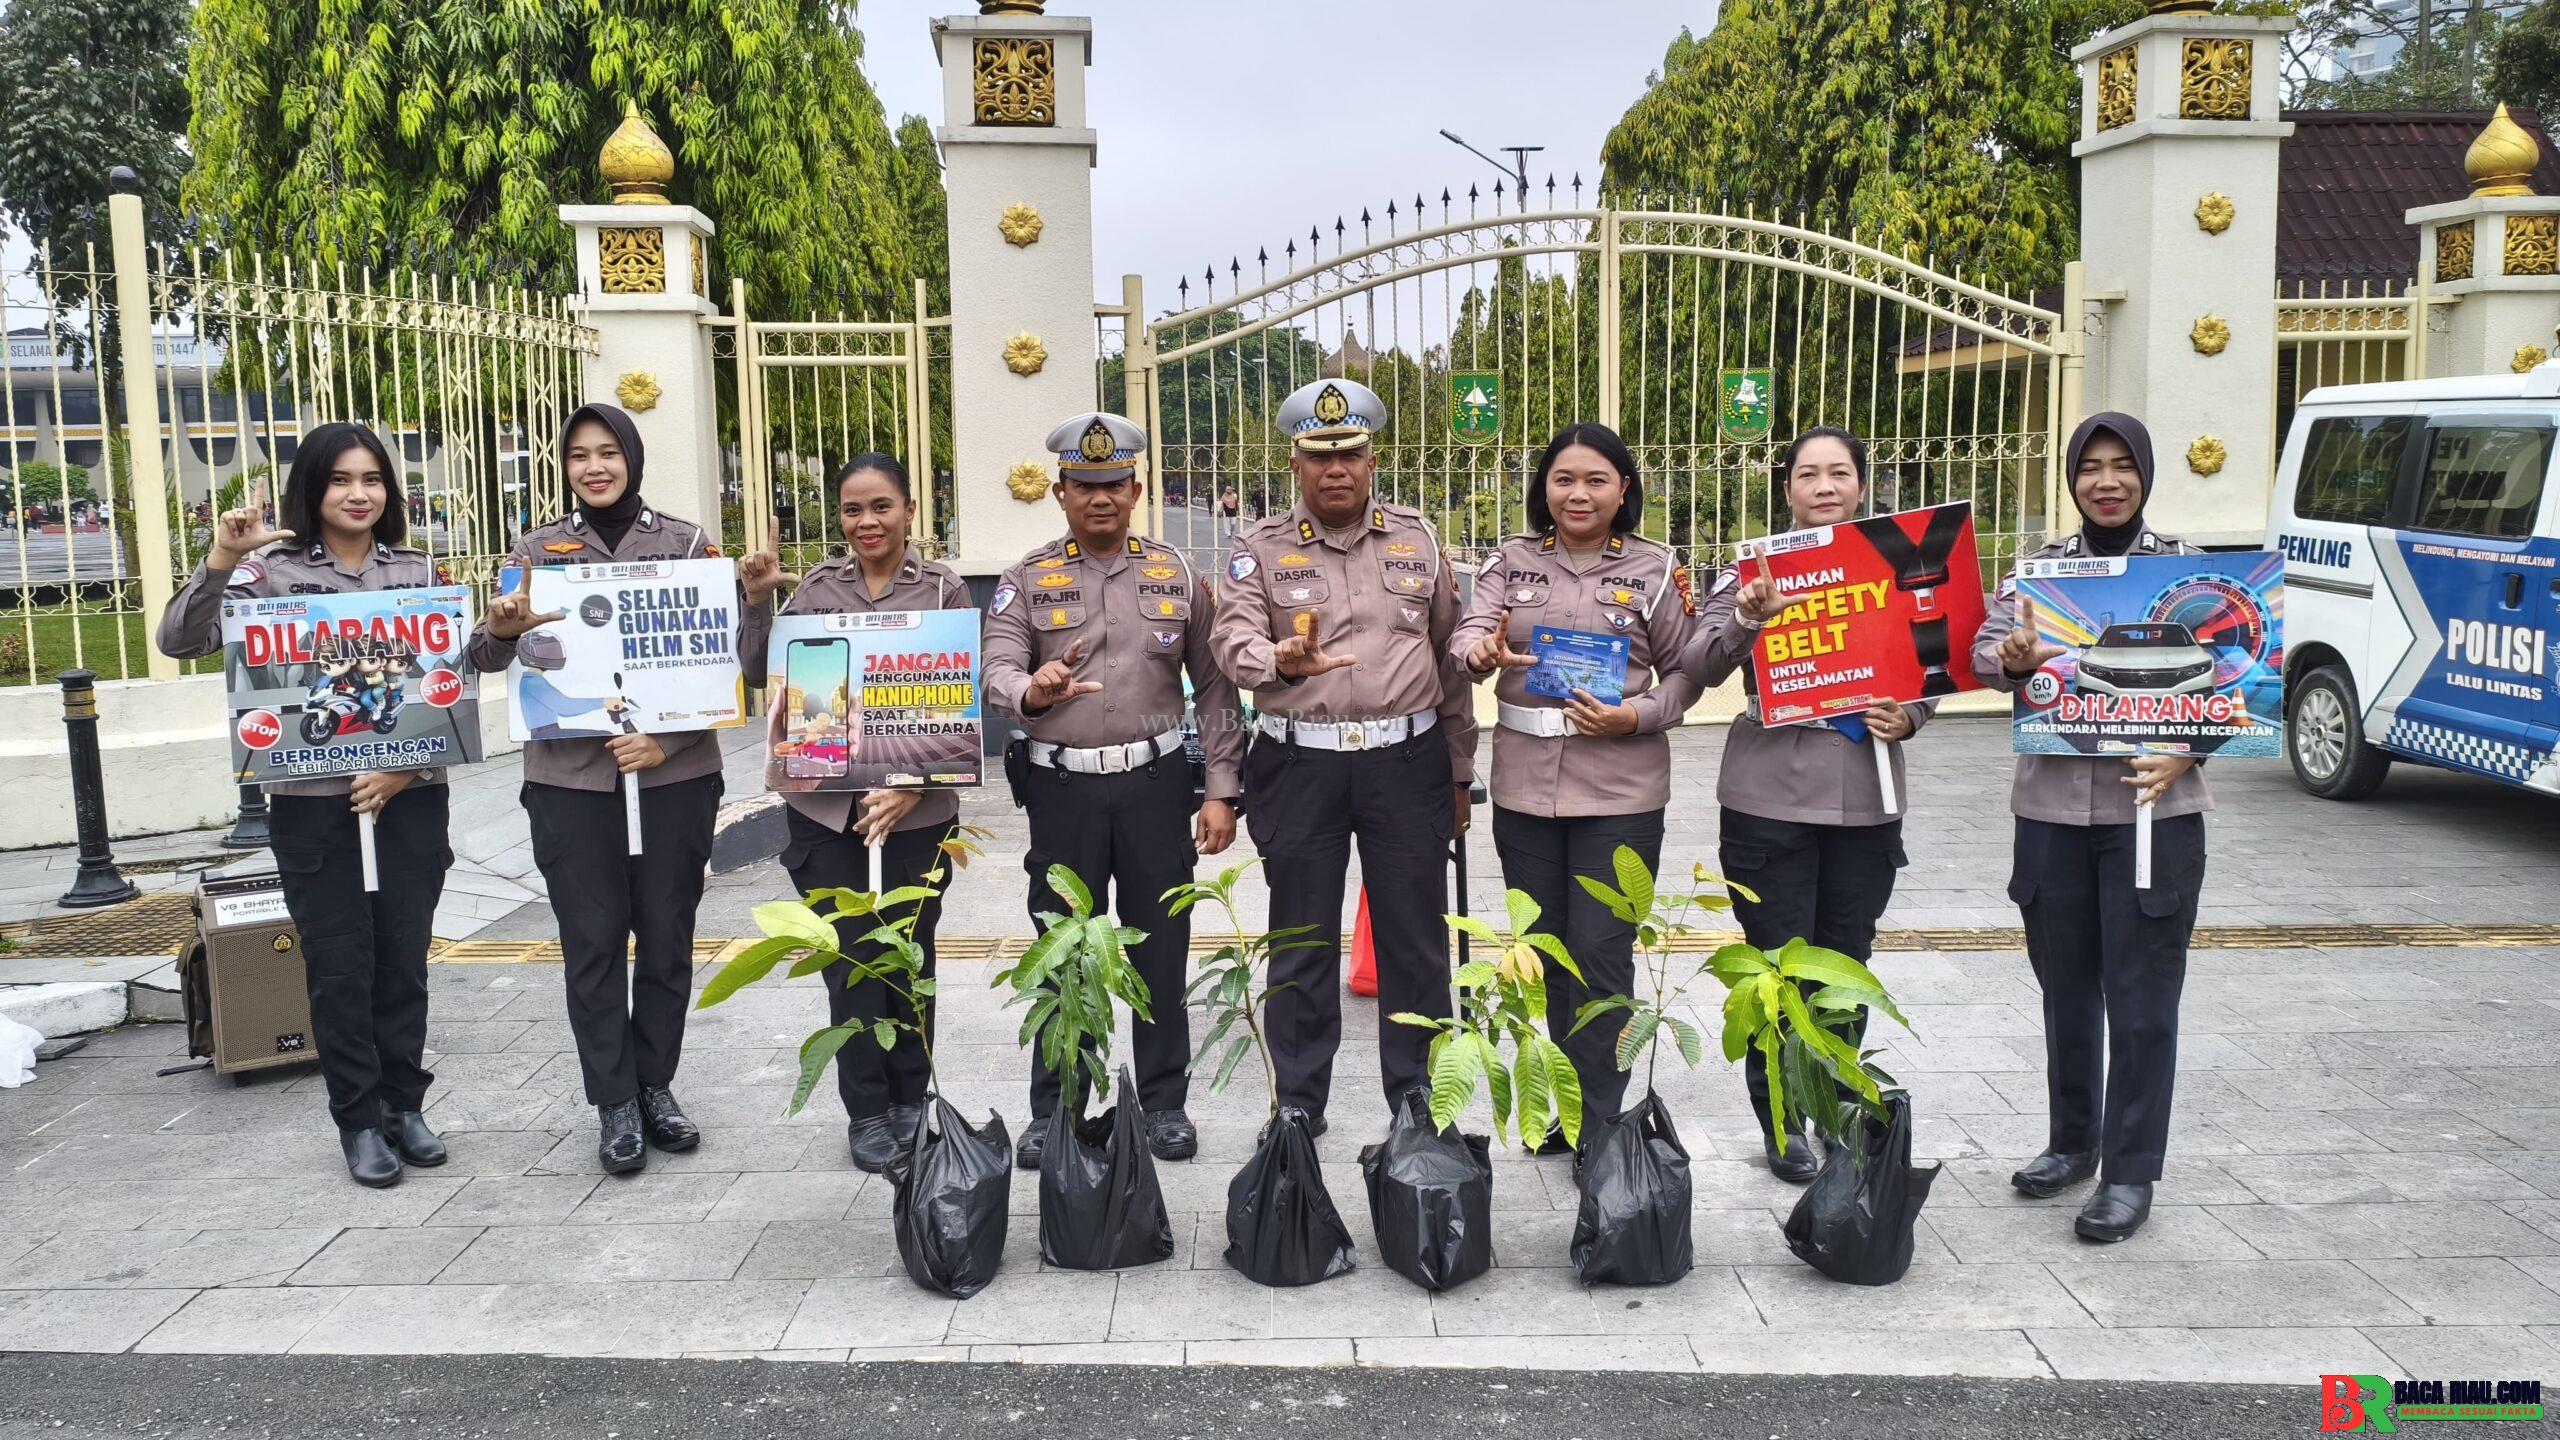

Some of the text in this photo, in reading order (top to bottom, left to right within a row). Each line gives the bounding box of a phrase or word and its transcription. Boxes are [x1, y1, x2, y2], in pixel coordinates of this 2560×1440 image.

[11, 345, 52, 357] SELAMA
[170, 344, 195, 354] 1447
[1772, 532, 1818, 548] DITLANTAS
[2278, 534, 2352, 568] PENLING
[2413, 544, 2556, 567] MELINDUNGI, MENGAYOMI DAN MELAYANI
[1384, 560, 1427, 573] POLRI
[2058, 561, 2110, 570] DITLANTAS
[1274, 569, 1320, 582] DASRIL
[1508, 570, 1550, 586] PITA
[1601, 576, 1646, 591] POLRI
[1775, 567, 1845, 592] UNAKAN
[1032, 590, 1081, 605] FAJRI
[1138, 582, 1185, 596] POLRI
[618, 586, 699, 612] SELALU
[589, 610, 604, 618] SNI
[618, 608, 728, 635] GUNAKAN
[245, 612, 451, 667] DILARANG
[622, 632, 729, 660] HELM SNI
[1764, 622, 1848, 663] BELT
[2447, 618, 2545, 675] POLISI
[624, 657, 734, 671] SAAT BERKENDARA
[863, 652, 970, 672] JANGAN
[1769, 661, 1817, 680] UNTUK
[863, 671, 971, 684] MENGGUNAKAN
[1772, 666, 1874, 695] KESELAMATAN
[2032, 677, 2052, 691] 60
[424, 679, 459, 698] STOP
[2447, 672, 2543, 701] LALU LINTAS
[862, 684, 974, 707] HANDPHONE
[2034, 692, 2052, 700] km/h
[863, 709, 906, 721] SAAT
[2059, 694, 2232, 722] DILARANG
[241, 721, 279, 738] STOP
[863, 722, 976, 736] BERKENDARA
[2021, 723, 2273, 736] BERKENDARA MELEBIHI BATAS KECEPATAN
[270, 737, 446, 766] BERBONCENGAN
[288, 754, 430, 776] LEBIH DARI 1 ORANG
[243, 898, 285, 908] BHAYA
